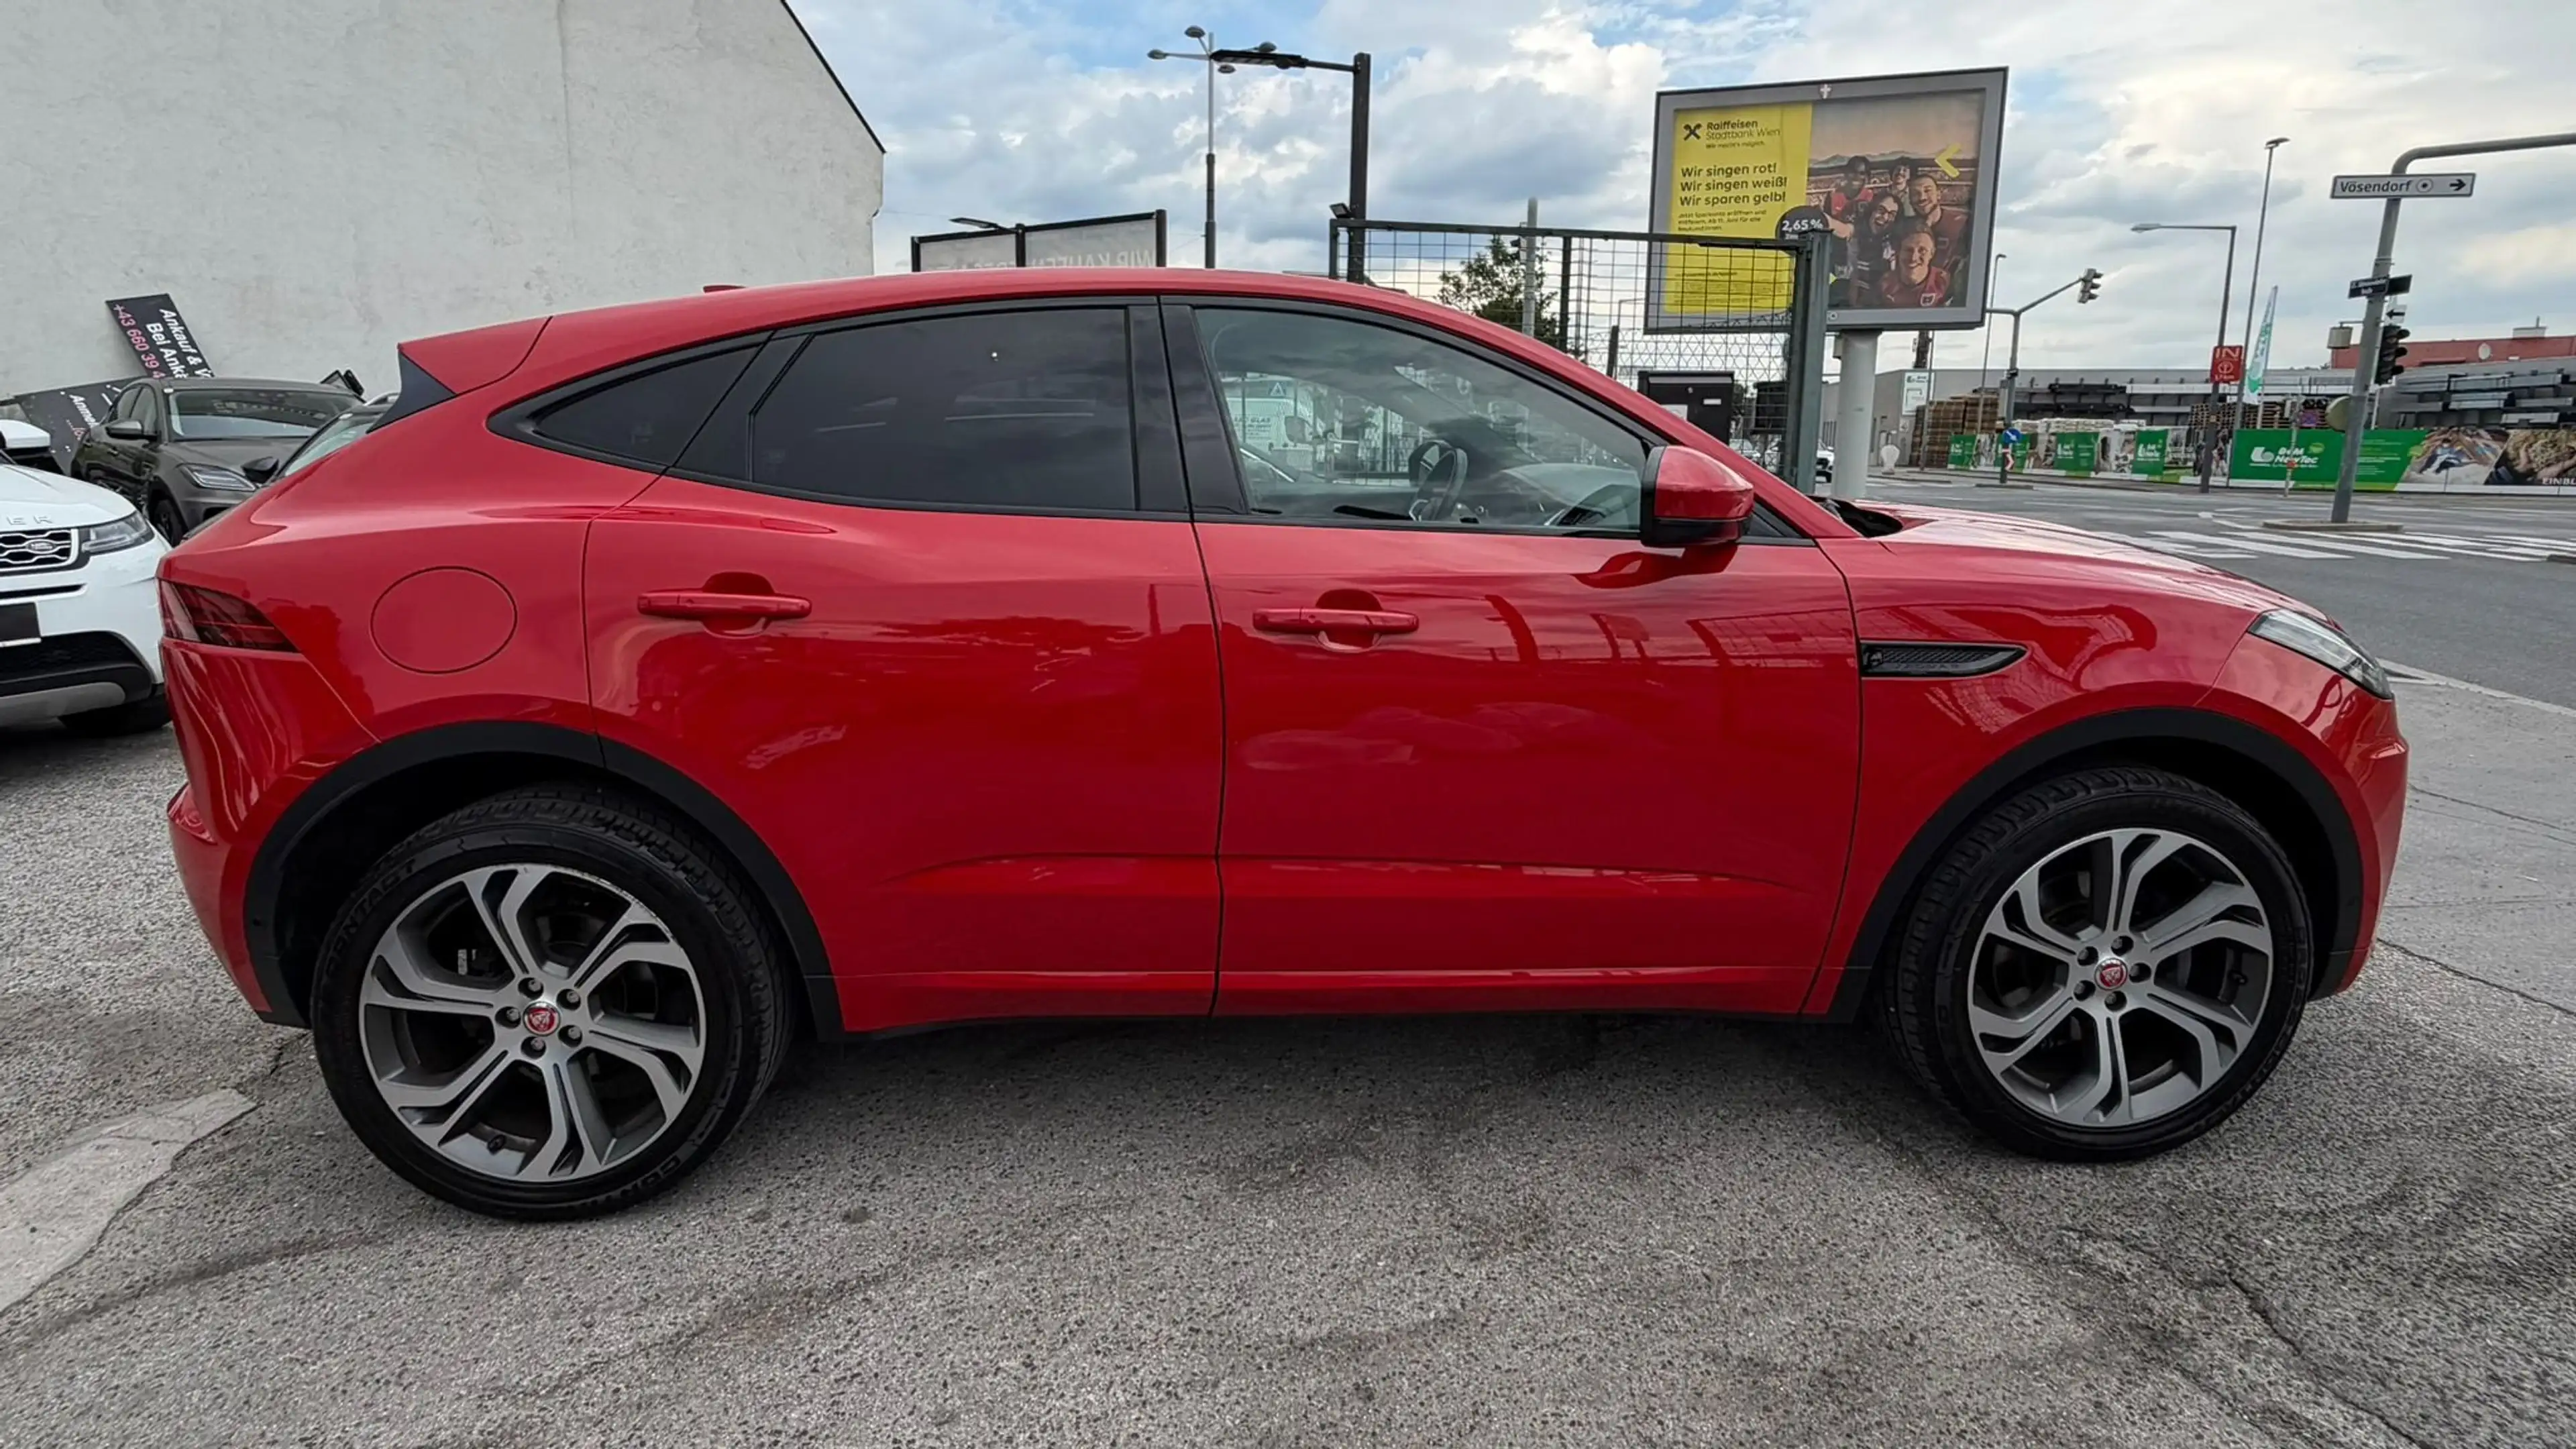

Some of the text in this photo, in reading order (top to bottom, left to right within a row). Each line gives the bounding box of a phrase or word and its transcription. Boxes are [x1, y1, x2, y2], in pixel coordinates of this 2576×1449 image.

[1707, 119, 1758, 131] Raiffeisen
[1706, 127, 1781, 140] Stadtbank Wien
[1681, 163, 1777, 178] Wir singen rot!
[1680, 176, 1787, 192] Wir singen weiß!
[2341, 180, 2413, 193] Vösendorf
[1680, 192, 1786, 207] Wir sparen gelb!
[113, 303, 136, 327] +43
[126, 329, 150, 351] 660
[141, 353, 160, 368] 39
[159, 309, 198, 354] Ankauf
[186, 356, 201, 366] &
